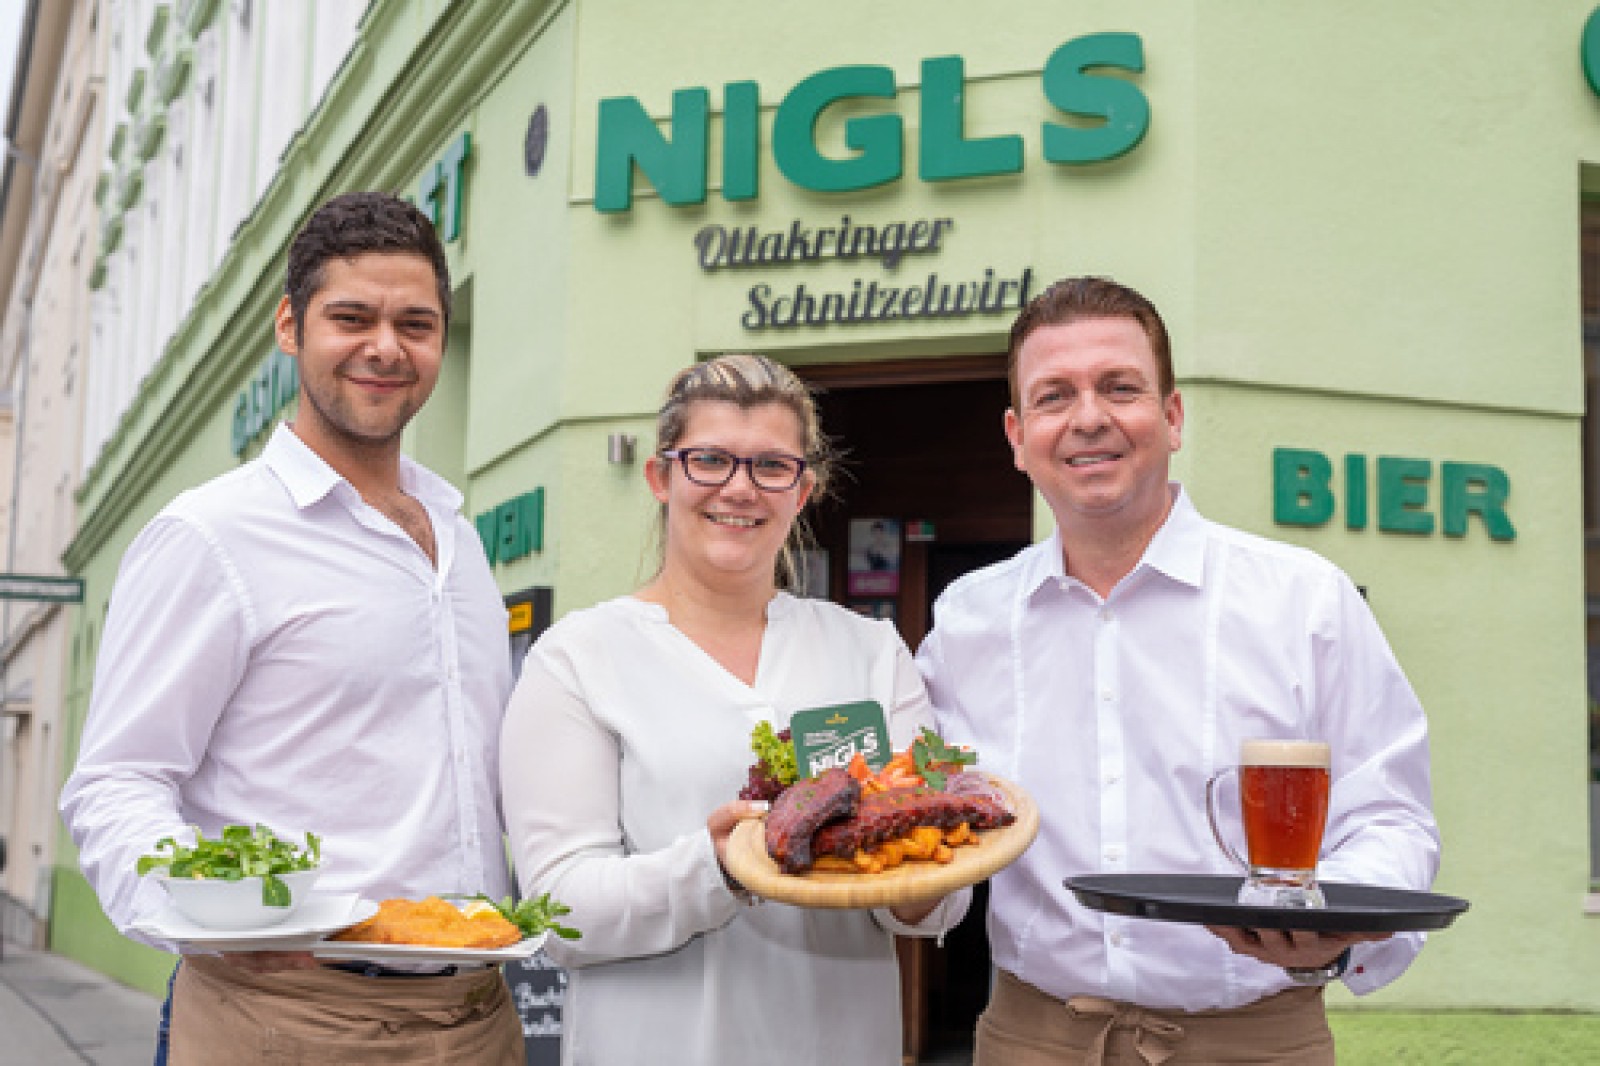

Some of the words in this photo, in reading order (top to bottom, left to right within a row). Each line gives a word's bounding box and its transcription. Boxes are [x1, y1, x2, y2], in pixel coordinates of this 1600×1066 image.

[594, 32, 1151, 213] NIGLS
[694, 215, 953, 273] Ottakringer
[741, 268, 1033, 331] Schnitzelwirt
[1273, 447, 1516, 541] BIER
